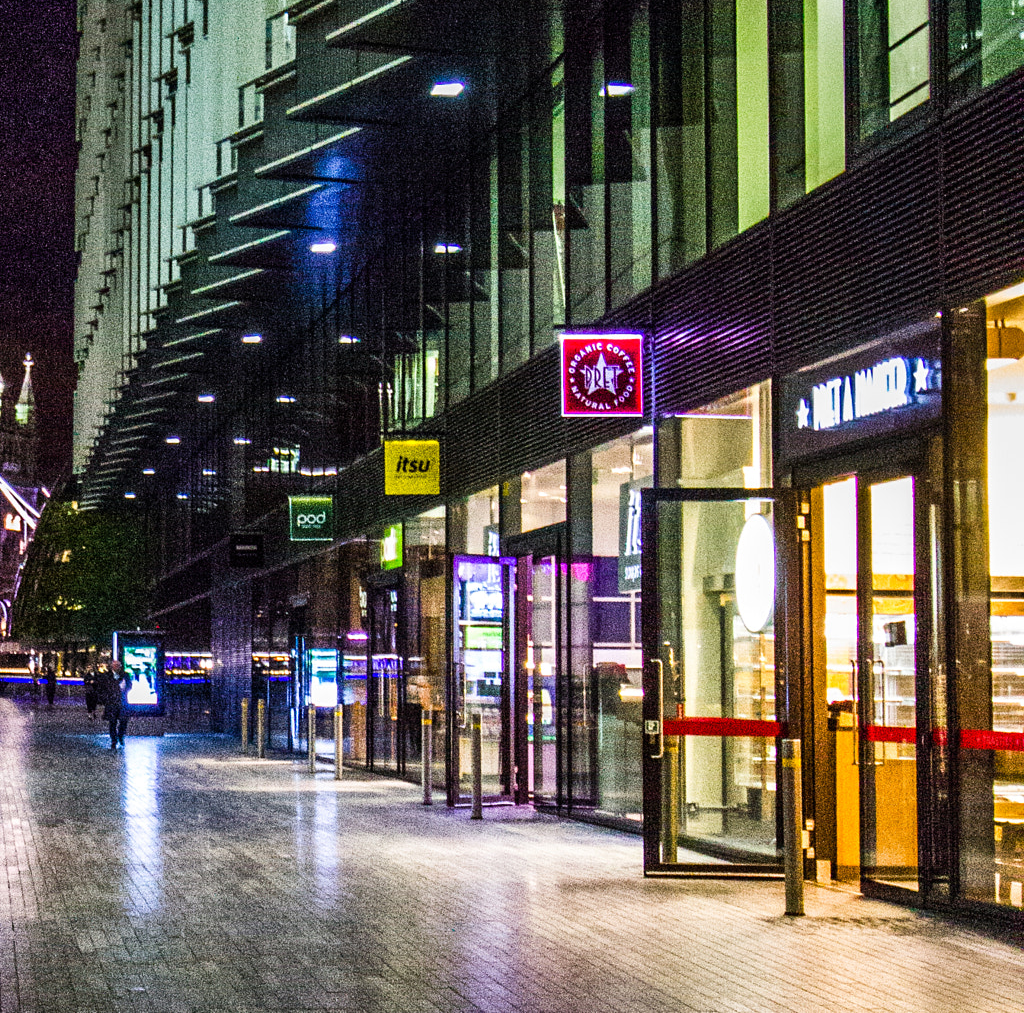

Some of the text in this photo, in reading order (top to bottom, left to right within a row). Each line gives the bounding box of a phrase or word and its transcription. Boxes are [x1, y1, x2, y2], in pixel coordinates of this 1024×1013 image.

[568, 342, 635, 374] ORGANIC COFFEE
[584, 365, 620, 389] PRET
[571, 385, 611, 410] NATURAL
[396, 455, 431, 473] itsu
[297, 511, 326, 527] pod
